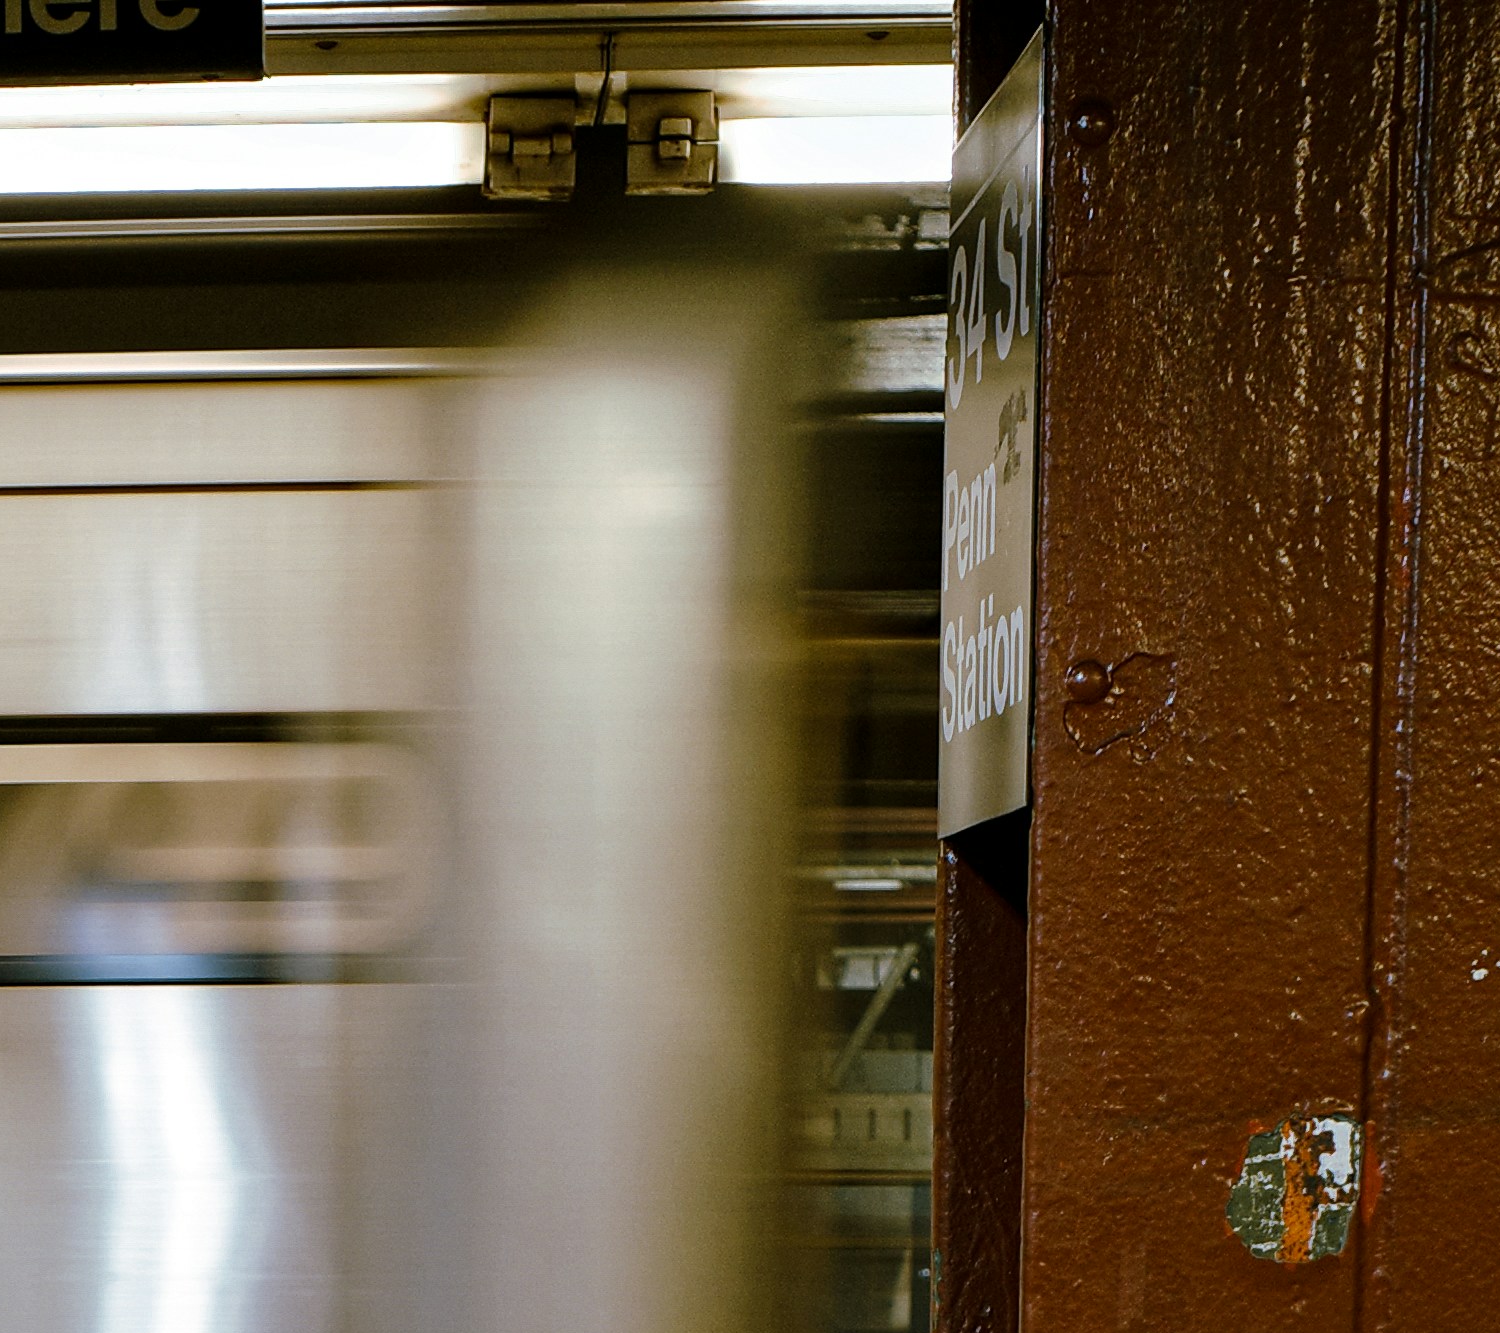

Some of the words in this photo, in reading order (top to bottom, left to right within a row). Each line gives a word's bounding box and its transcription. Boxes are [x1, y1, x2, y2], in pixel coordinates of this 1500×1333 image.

[949, 216, 987, 411] 34
[995, 163, 1033, 361] St
[943, 462, 997, 593] Penn
[942, 592, 1024, 743] Station
